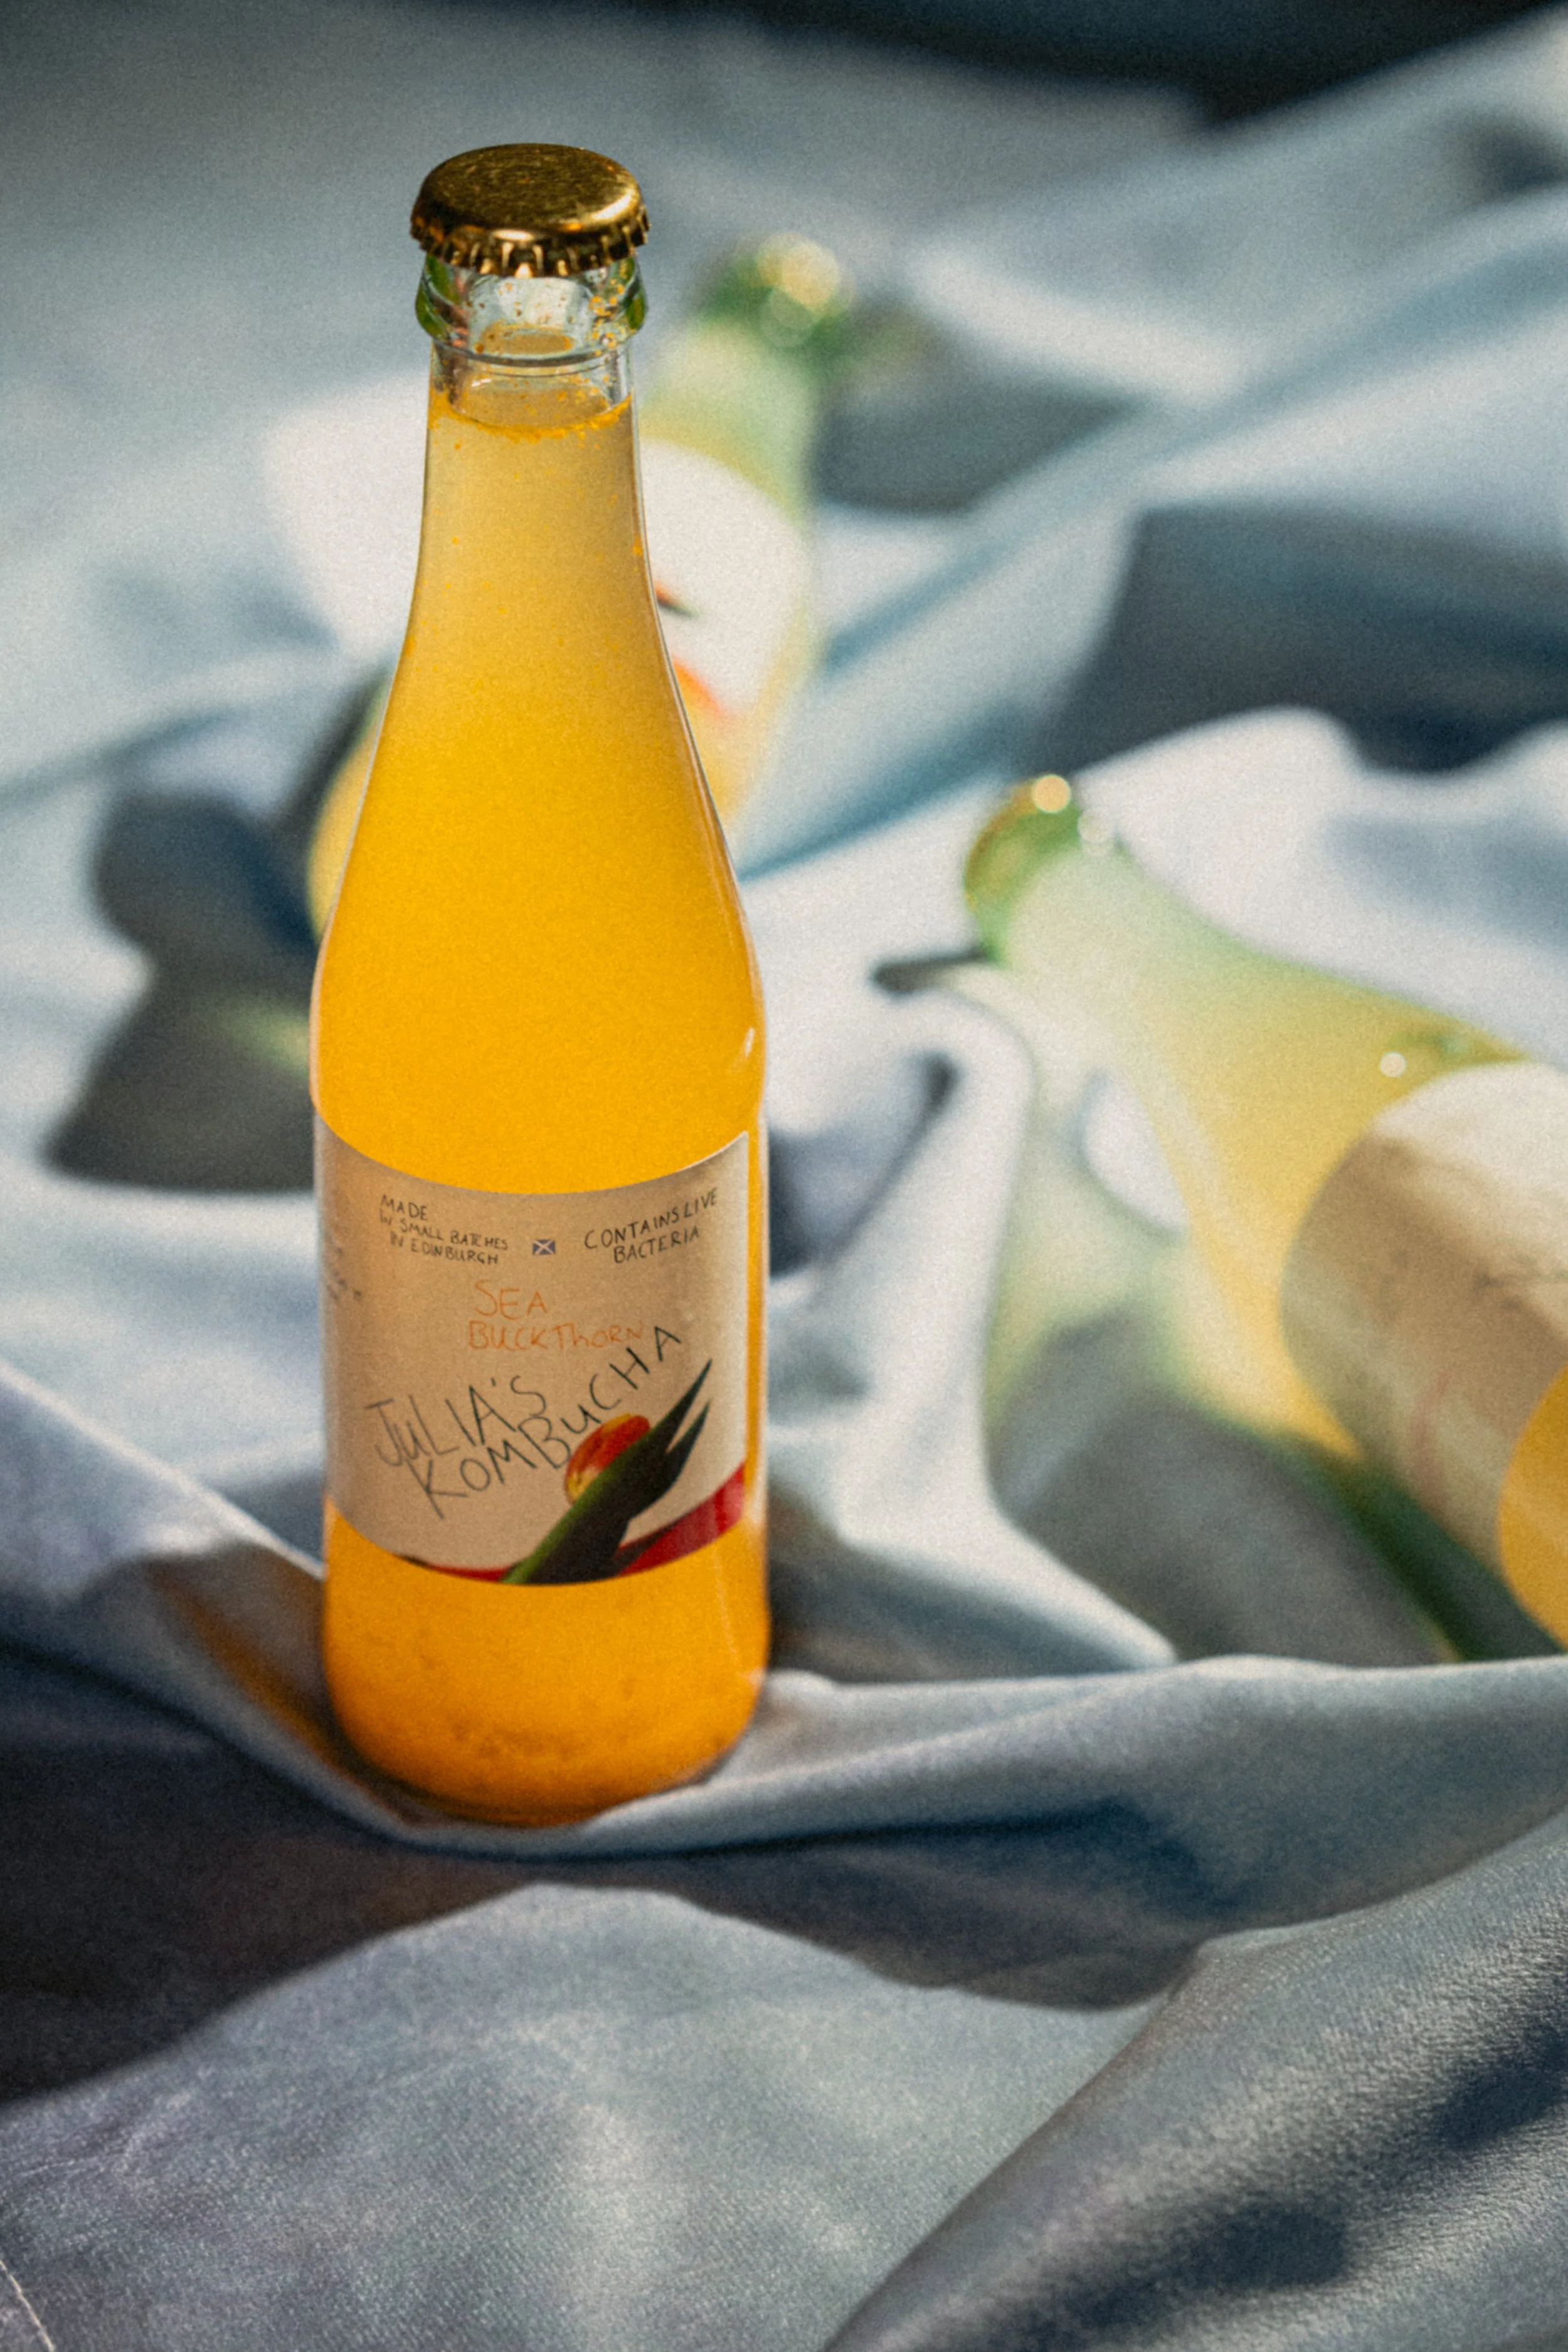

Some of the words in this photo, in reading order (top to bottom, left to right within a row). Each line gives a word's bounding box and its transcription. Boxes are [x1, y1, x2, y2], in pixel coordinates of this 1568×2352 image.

[379, 1194, 428, 1221] MADE
[584, 1206, 680, 1249] CONTAINS
[684, 1187, 718, 1219] LIVE
[399, 1217, 444, 1241] SMALL
[450, 1229, 509, 1251] BATCHES
[411, 1237, 499, 1265] EDINBURGH
[613, 1225, 699, 1264] BACTERIA
[474, 1279, 548, 1320] SEA
